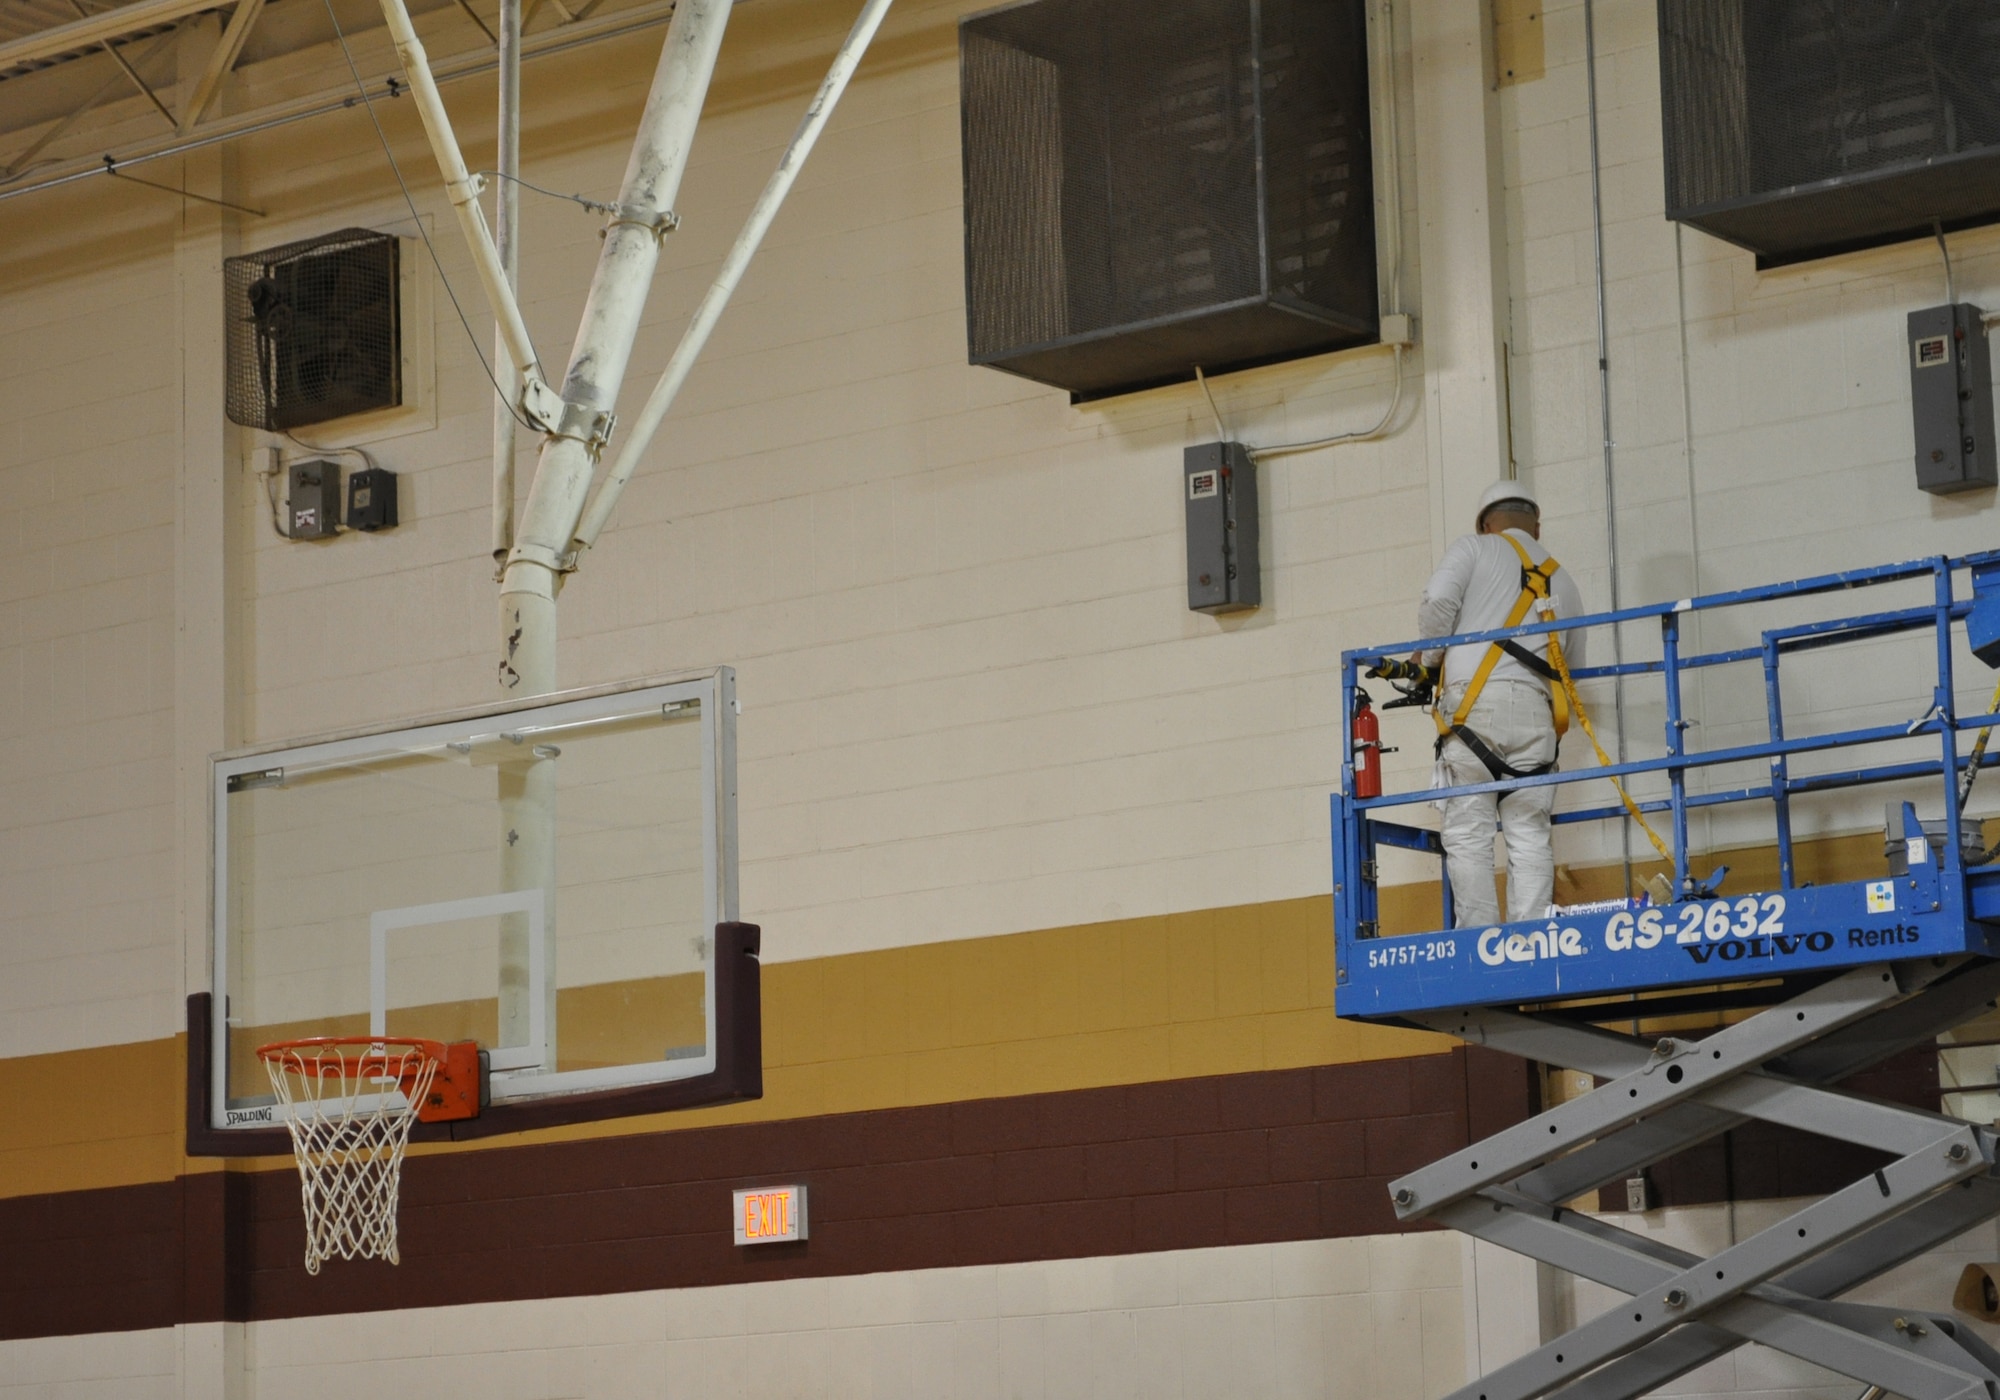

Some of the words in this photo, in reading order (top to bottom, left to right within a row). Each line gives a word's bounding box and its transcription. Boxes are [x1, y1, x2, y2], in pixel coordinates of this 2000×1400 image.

[1477, 922, 1582, 966] Genie
[1605, 895, 1786, 952] GS-2632
[1683, 932, 1834, 964] VOLVO
[1848, 924, 1919, 949] Rents
[1369, 940, 1456, 968] 54757-203
[226, 1107, 272, 1126] SPALDING
[745, 1192, 790, 1238] EXIT
